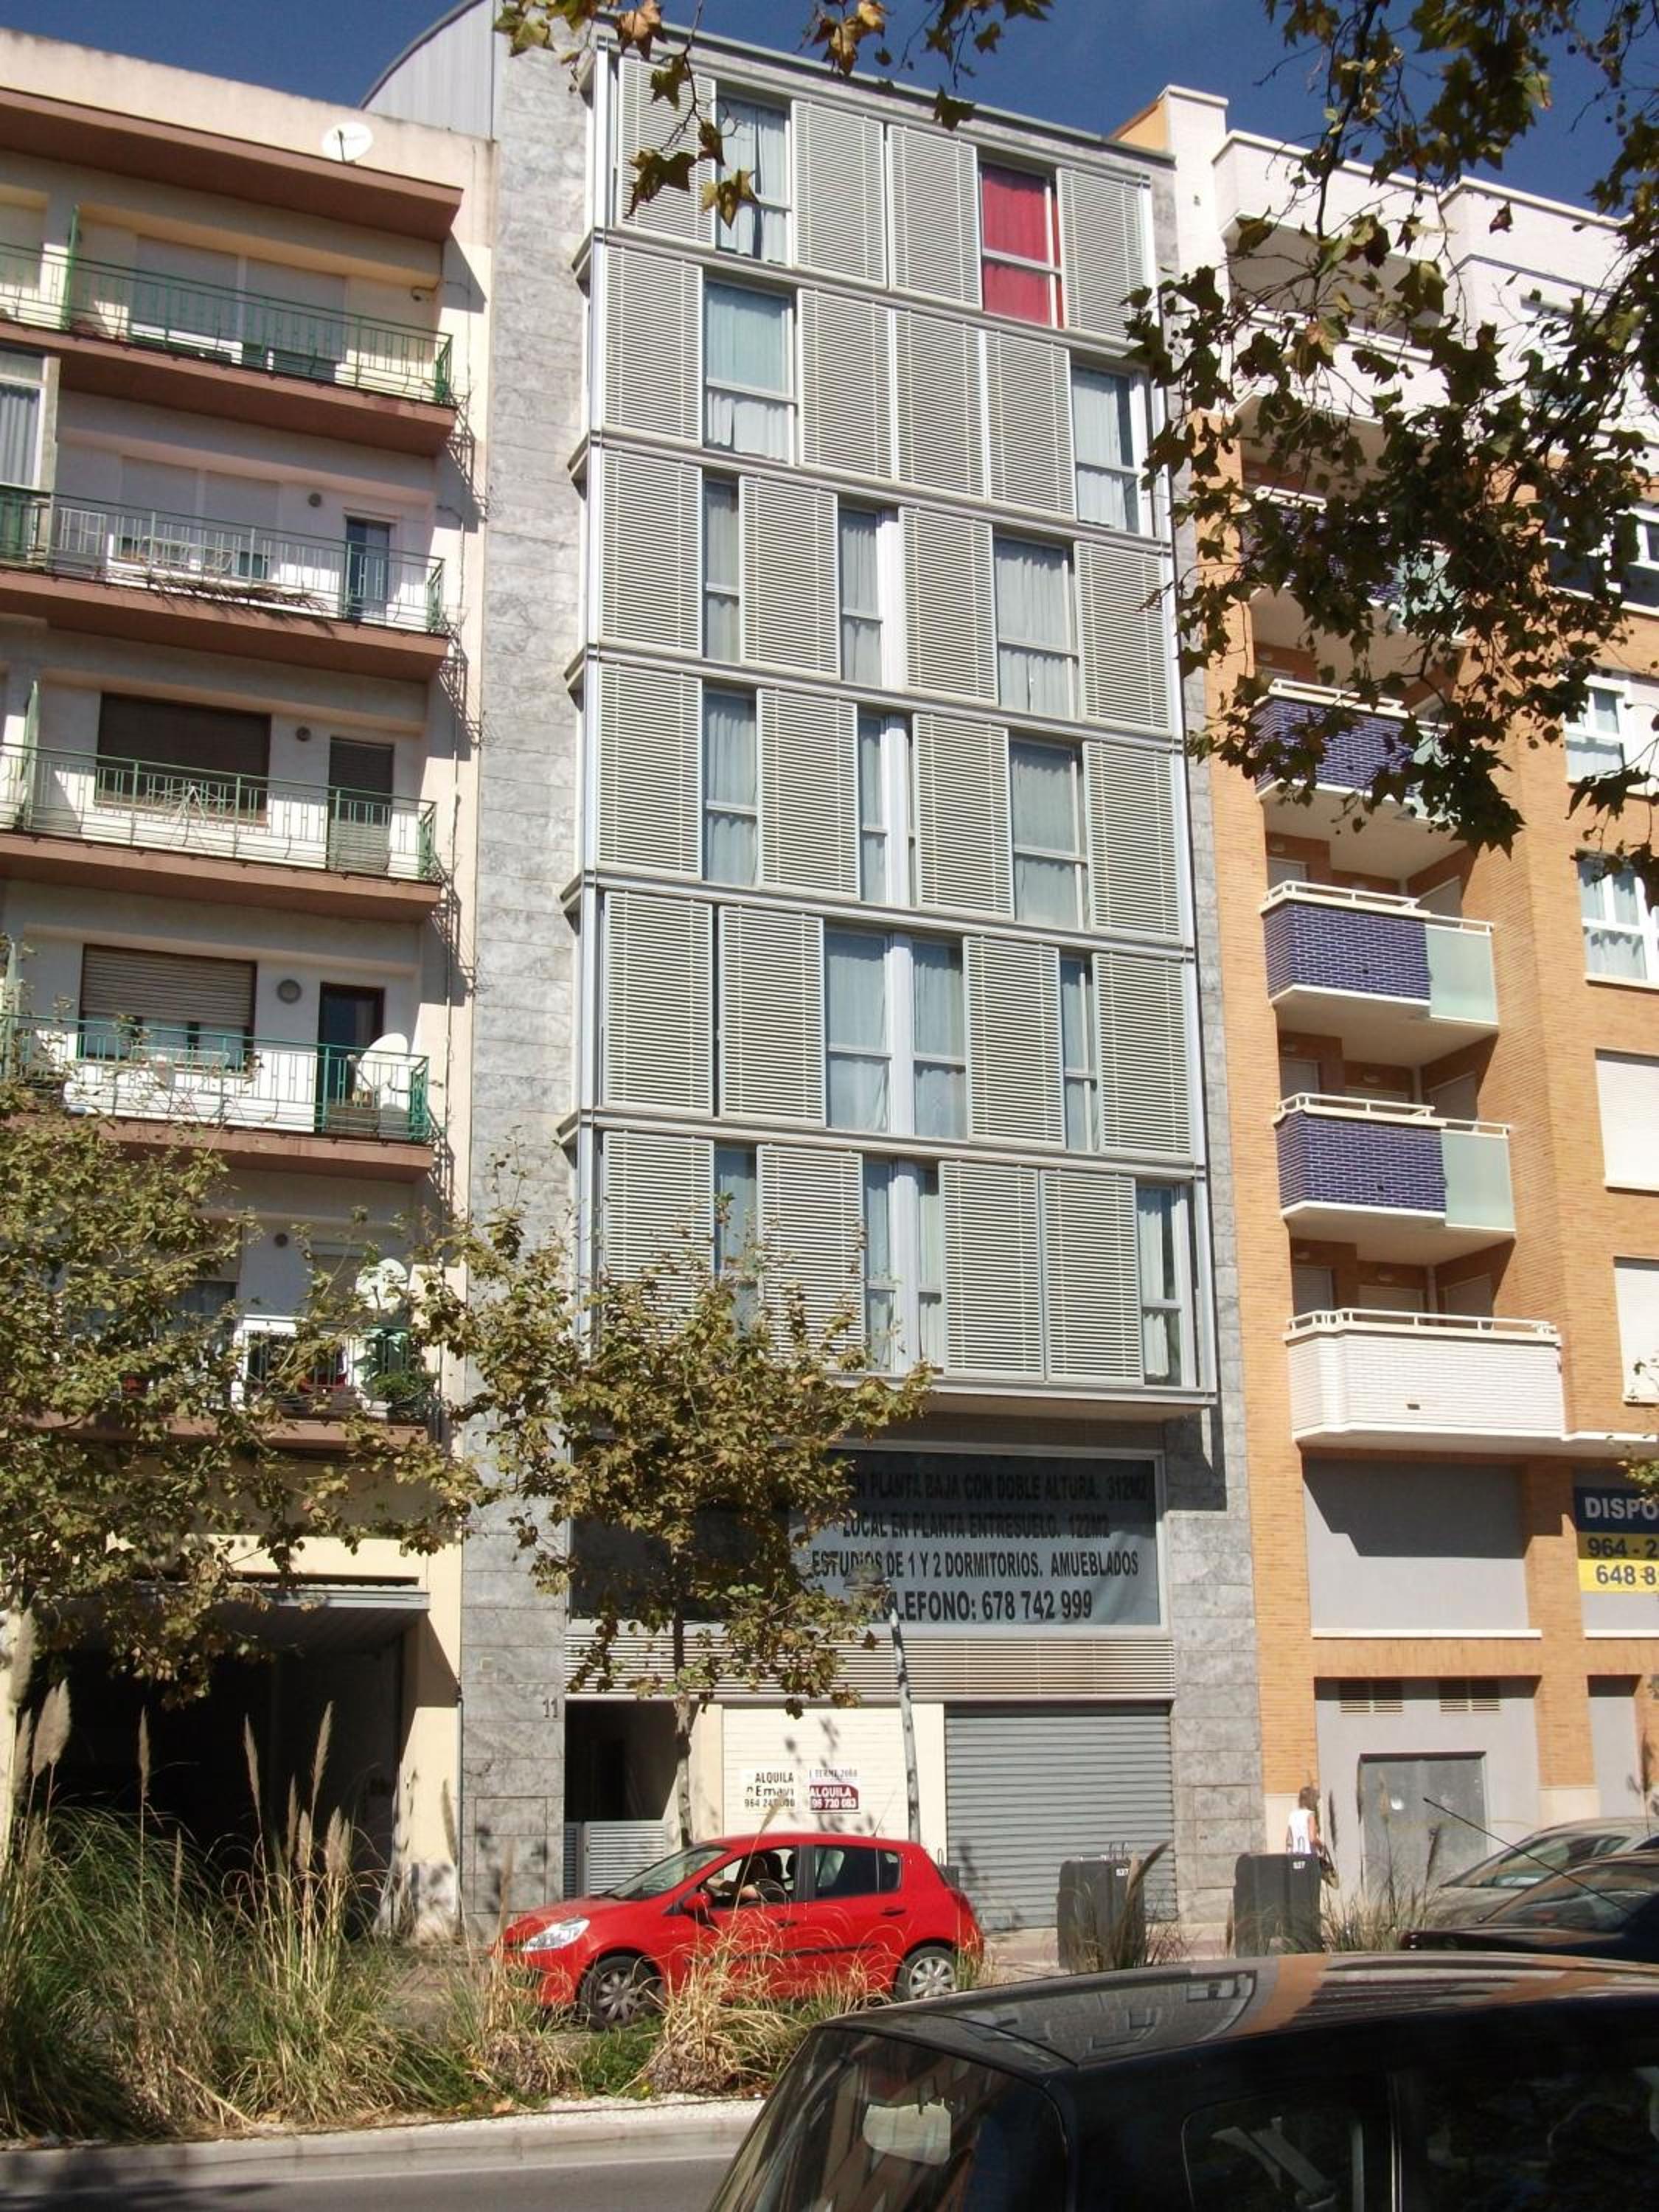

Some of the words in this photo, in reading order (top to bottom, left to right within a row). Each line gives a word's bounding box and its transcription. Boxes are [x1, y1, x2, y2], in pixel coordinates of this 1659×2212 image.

[871, 1474, 921, 1499] PLANTA
[965, 1474, 993, 1500] CON
[997, 1475, 1040, 1500] DOBLE
[844, 1511, 887, 1537] LOCAL
[891, 1512, 908, 1538] EN
[913, 1512, 964, 1538] PLANTA
[1587, 1537, 1628, 1558] 964
[886, 1551, 904, 1577] DE
[908, 1551, 916, 1577] 1
[919, 1551, 929, 1578] Y
[933, 1551, 942, 1578] 2
[945, 1551, 1043, 1578] DORMITORIOS.
[1050, 1551, 1139, 1577] AMUEBLADOS
[1596, 1564, 1636, 1585] 648
[981, 1590, 1015, 1621] 678
[1020, 1590, 1056, 1621] 742
[1060, 1589, 1093, 1620] 999
[542, 1698, 558, 1718] 11
[755, 1771, 794, 1784] ALQUILA
[810, 1787, 852, 1798] ALQUILA
